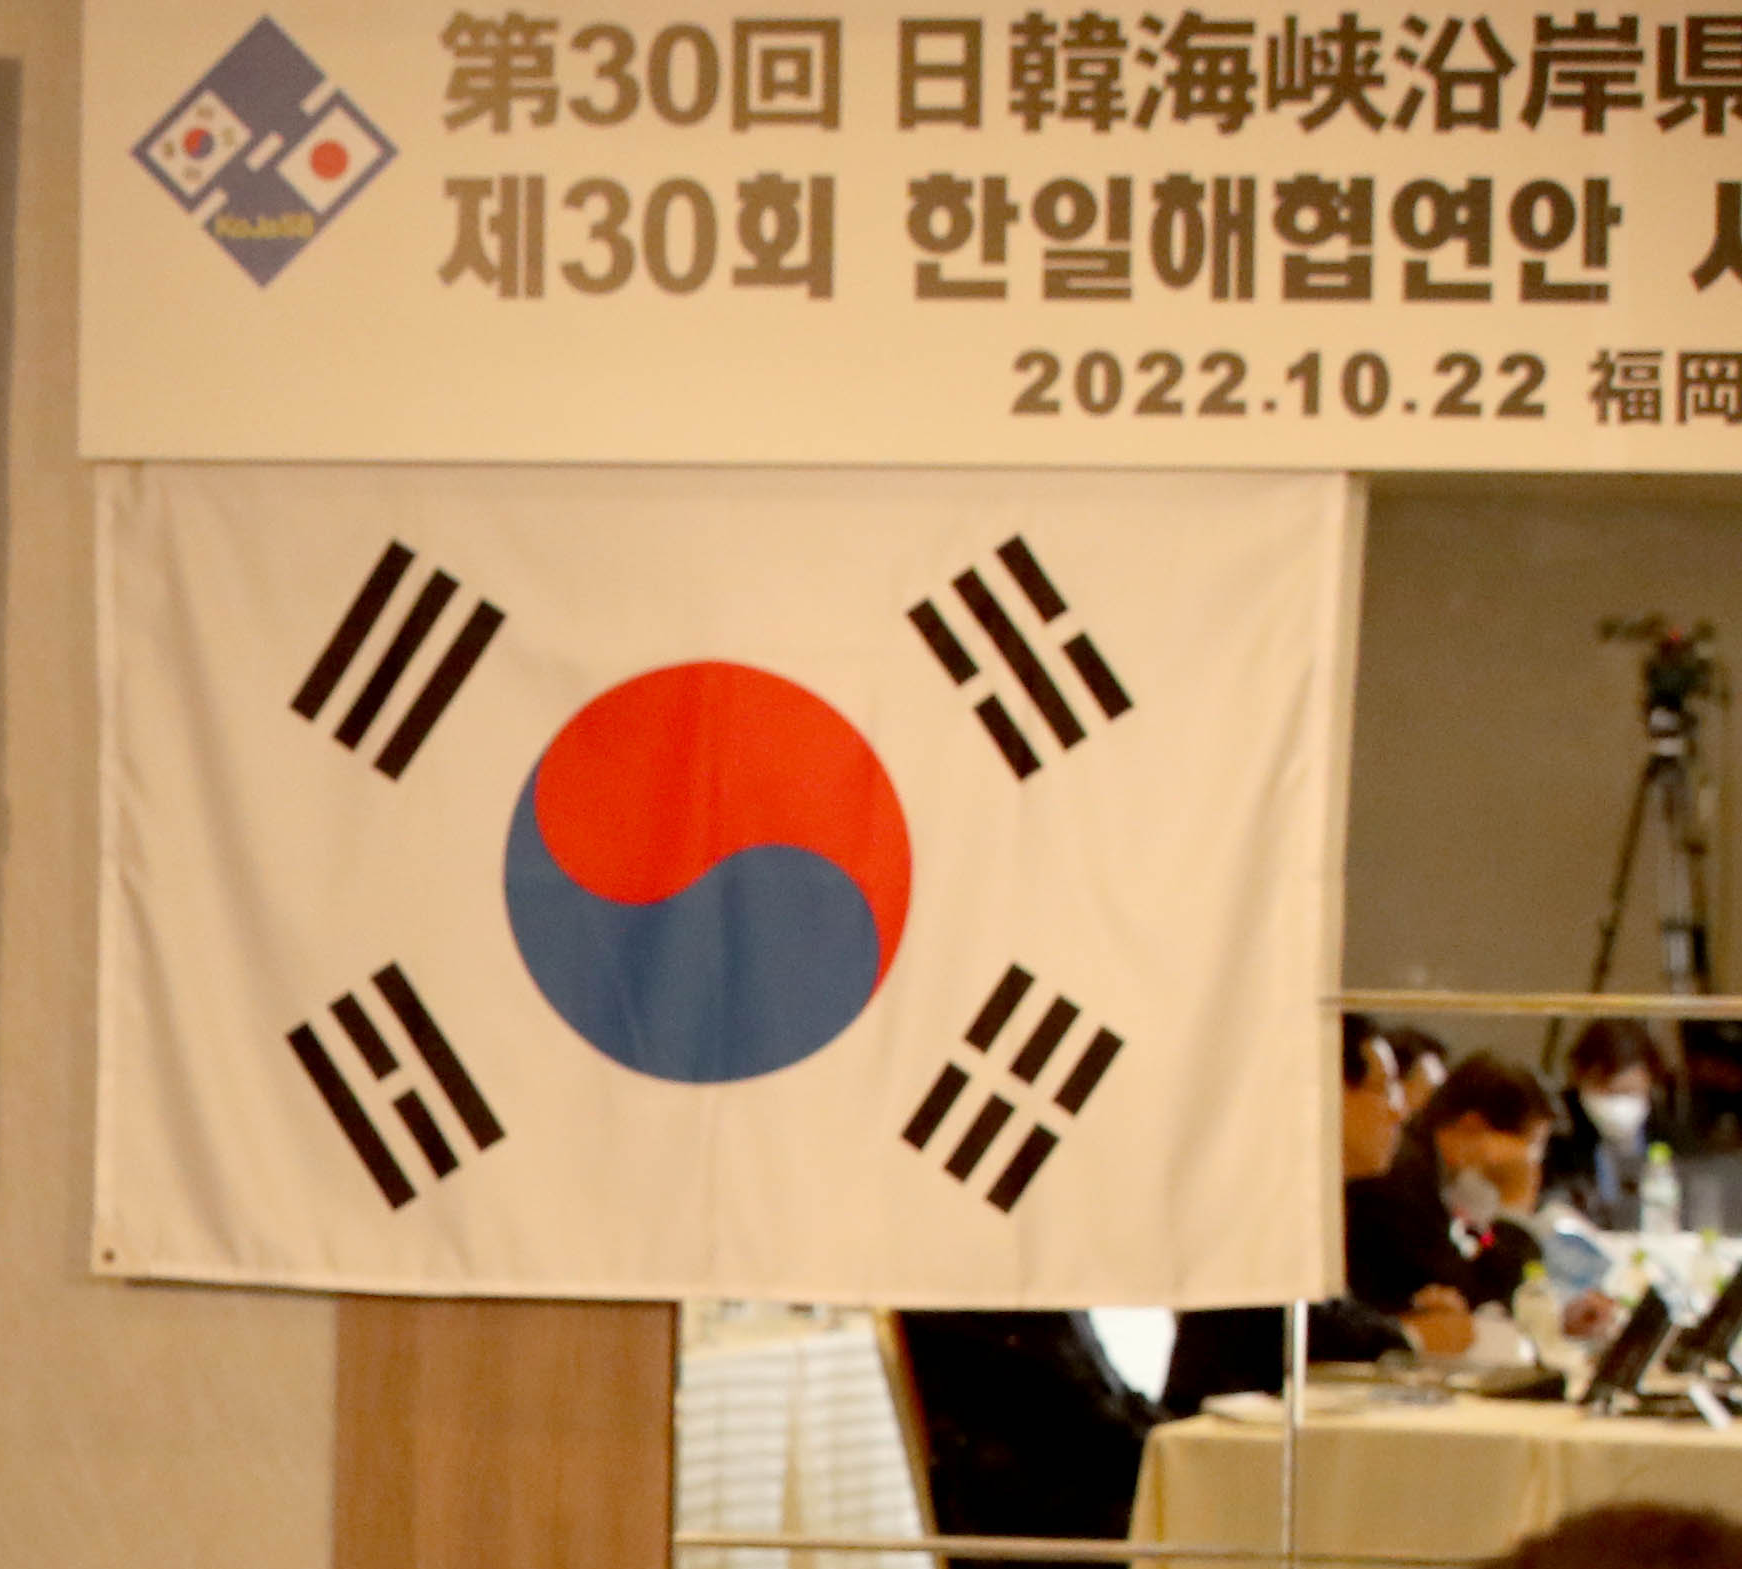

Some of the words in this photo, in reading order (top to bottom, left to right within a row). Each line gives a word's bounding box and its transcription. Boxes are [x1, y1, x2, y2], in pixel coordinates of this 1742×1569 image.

[438, 12, 841, 134] 第30回
[897, 11, 1742, 136] 日韓海峡沿岸県
[437, 173, 836, 300] 제30회
[905, 173, 1622, 302] 한일해협연안
[1010, 348, 1547, 417] 2022.10.22
